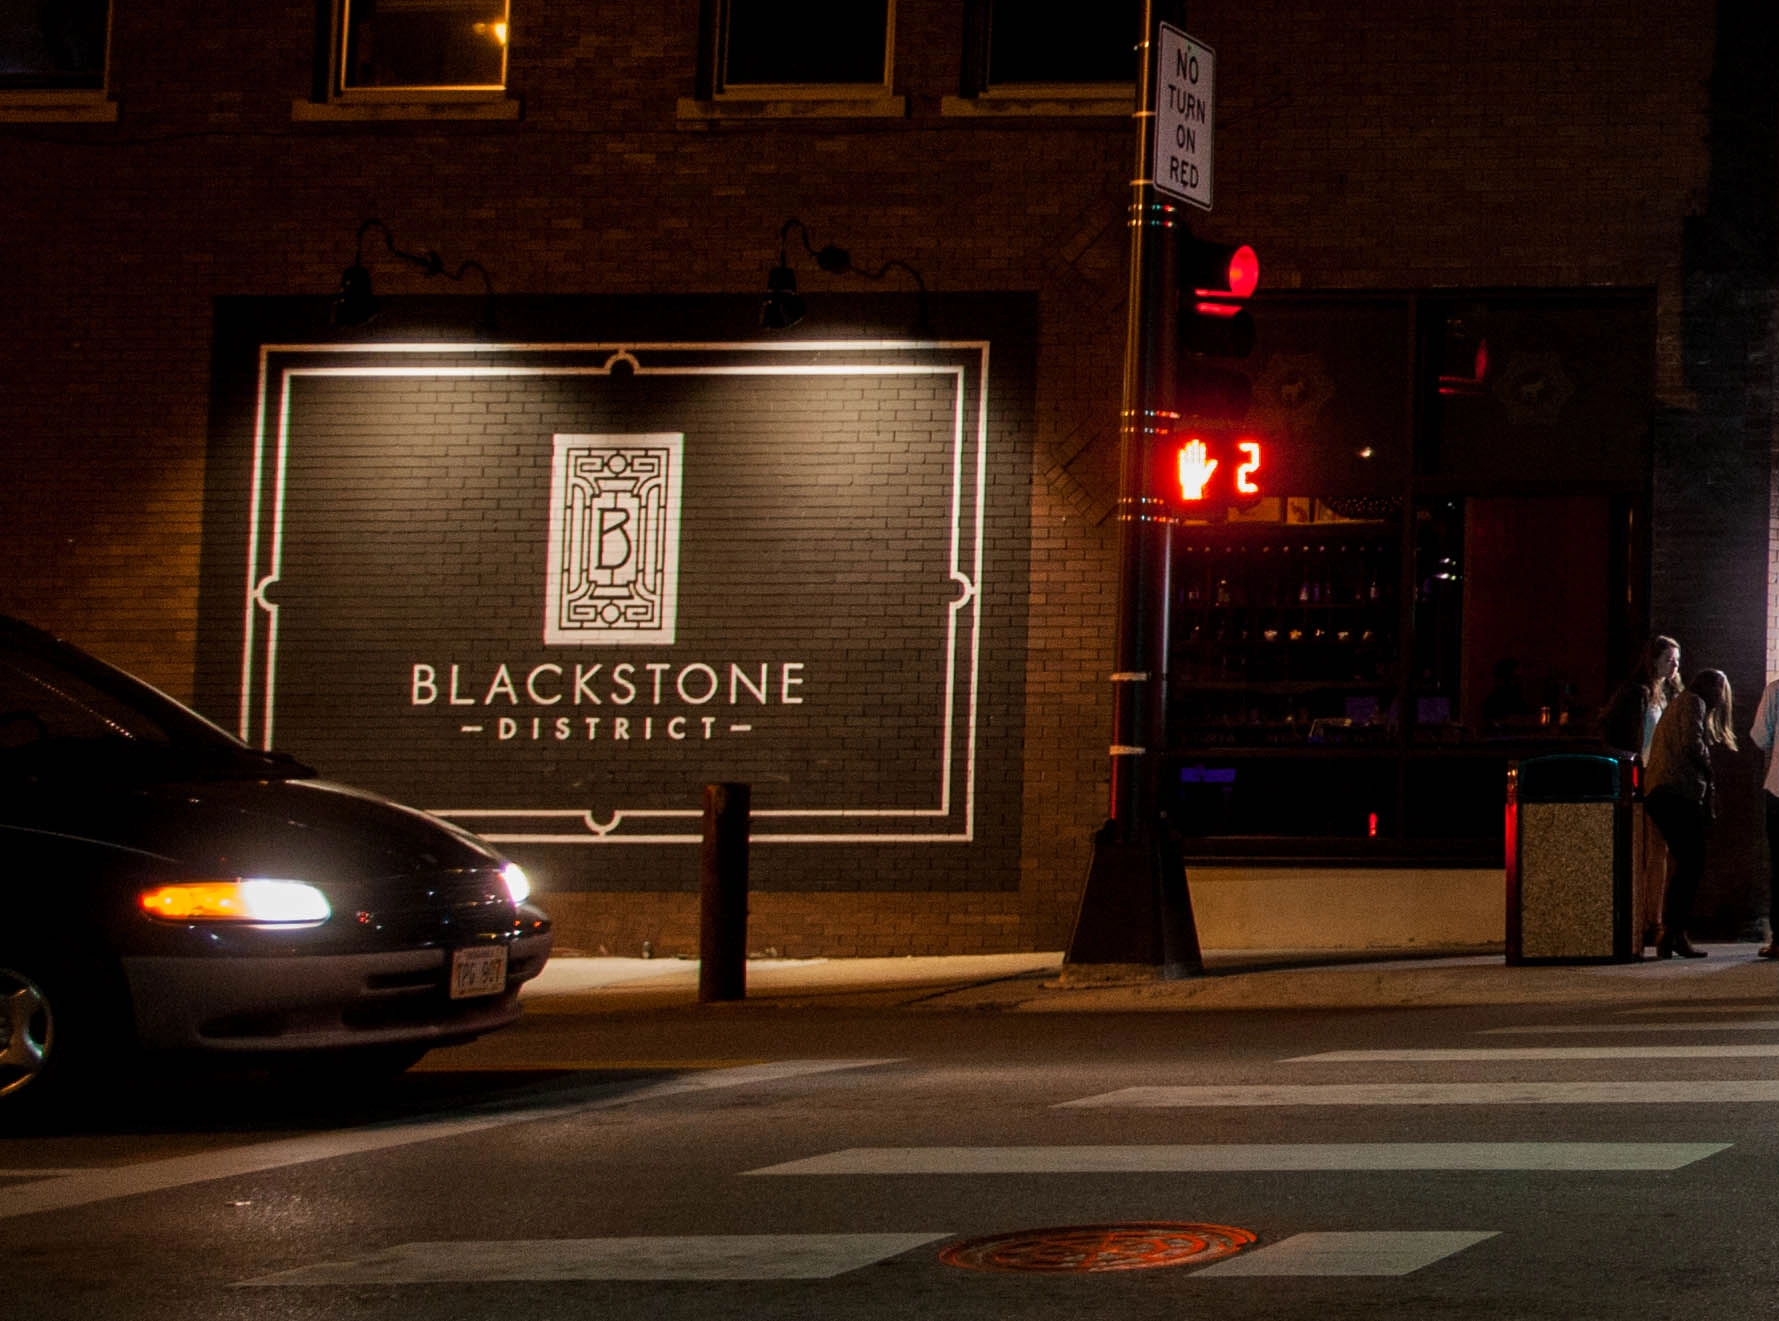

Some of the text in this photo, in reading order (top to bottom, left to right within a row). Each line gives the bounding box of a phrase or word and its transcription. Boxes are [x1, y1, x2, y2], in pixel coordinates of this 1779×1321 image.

[1177, 48, 1199, 84] NO
[1168, 84, 1205, 124] TURN
[1176, 125, 1196, 153] ON
[1170, 156, 1199, 188] RED
[1237, 443, 1260, 493] 2
[411, 663, 805, 705] BLACKSTONE
[498, 716, 718, 741] DISTRICT
